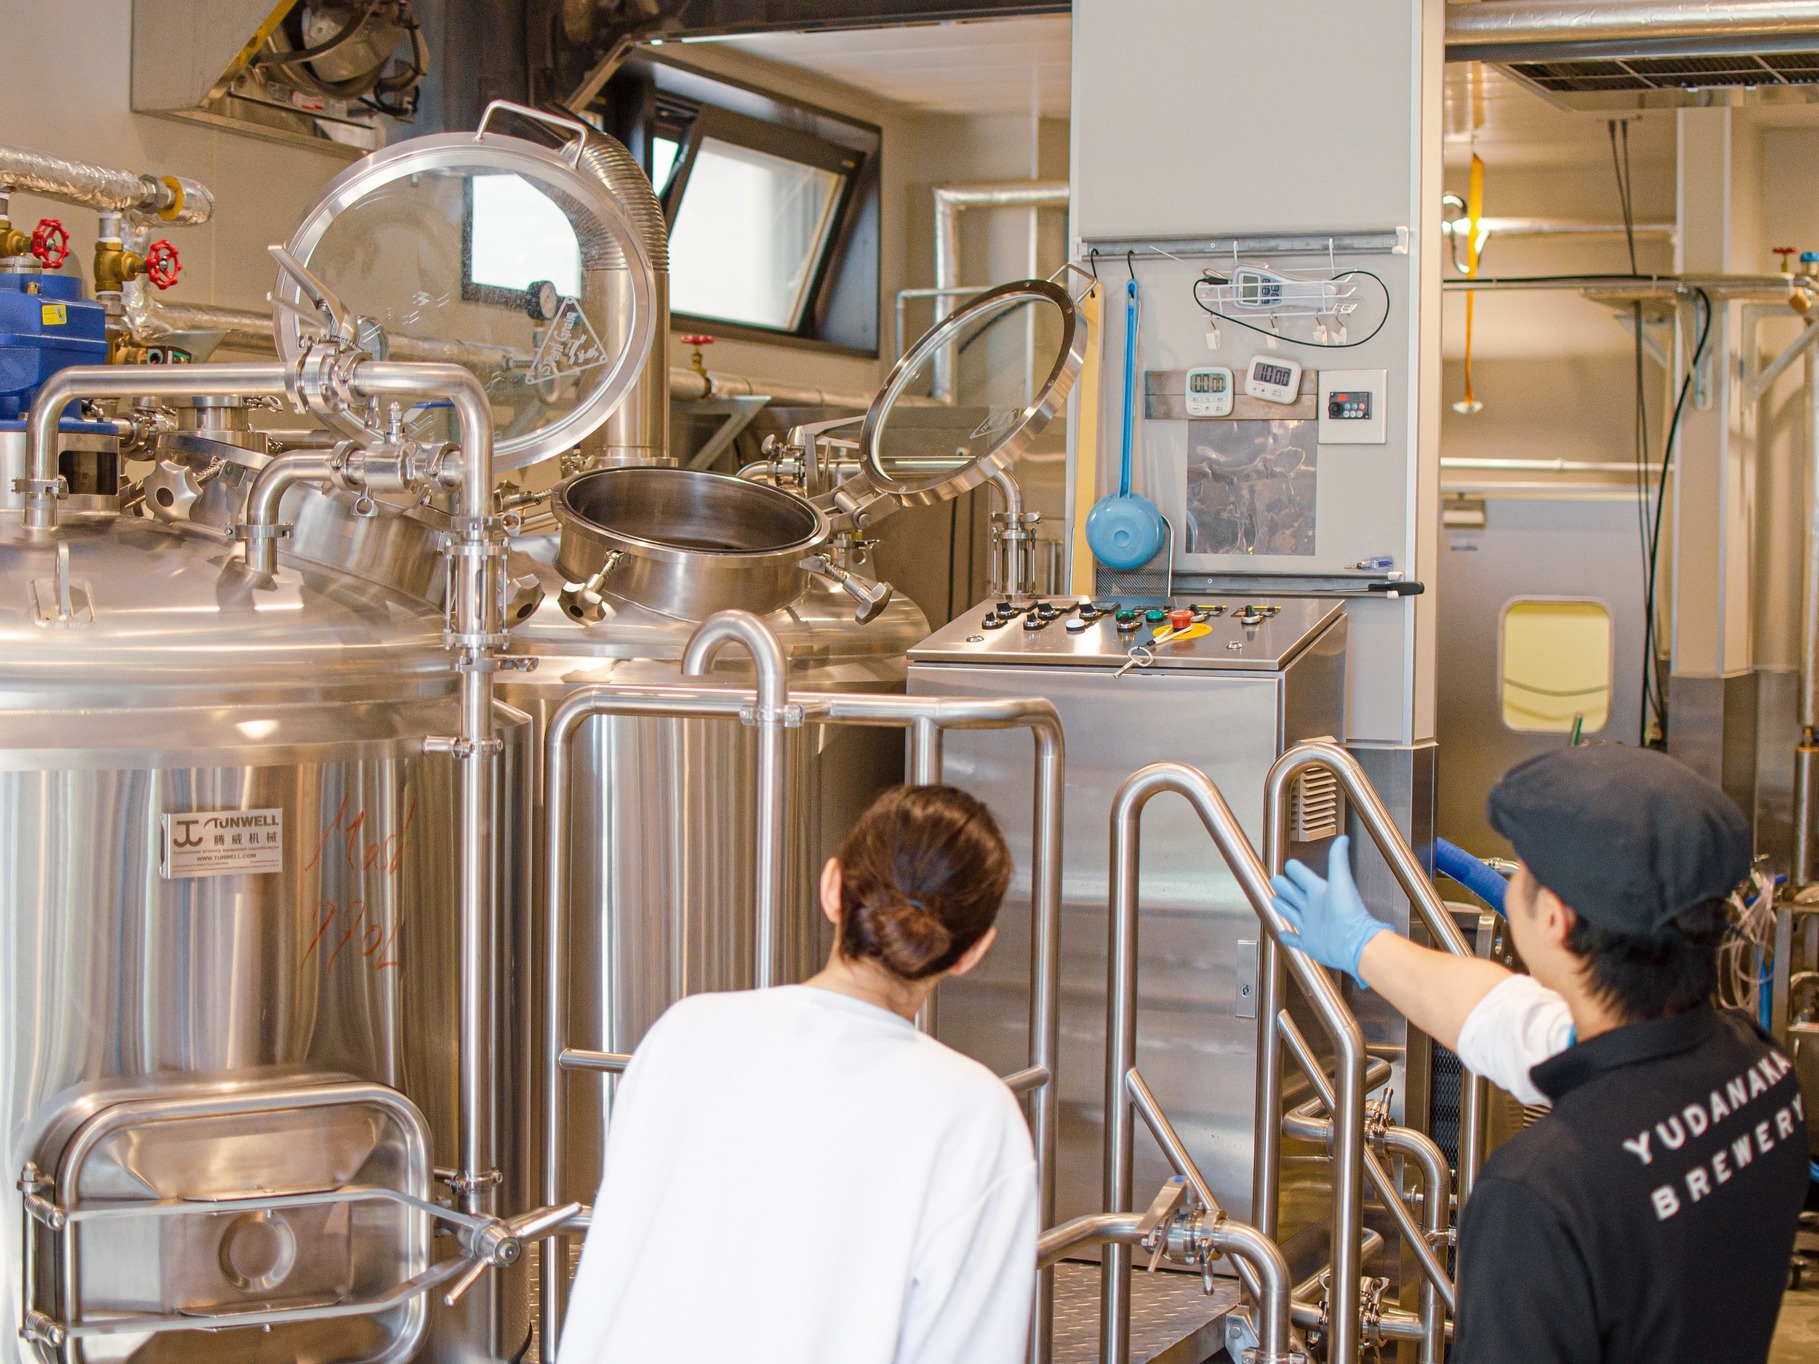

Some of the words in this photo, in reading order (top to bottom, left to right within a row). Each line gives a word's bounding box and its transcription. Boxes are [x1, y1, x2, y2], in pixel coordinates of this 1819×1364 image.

[203, 815, 280, 829] TUNWELL
[1621, 1050, 1792, 1166] YUDANAKA
[1650, 1093, 1804, 1221] BREWERY
